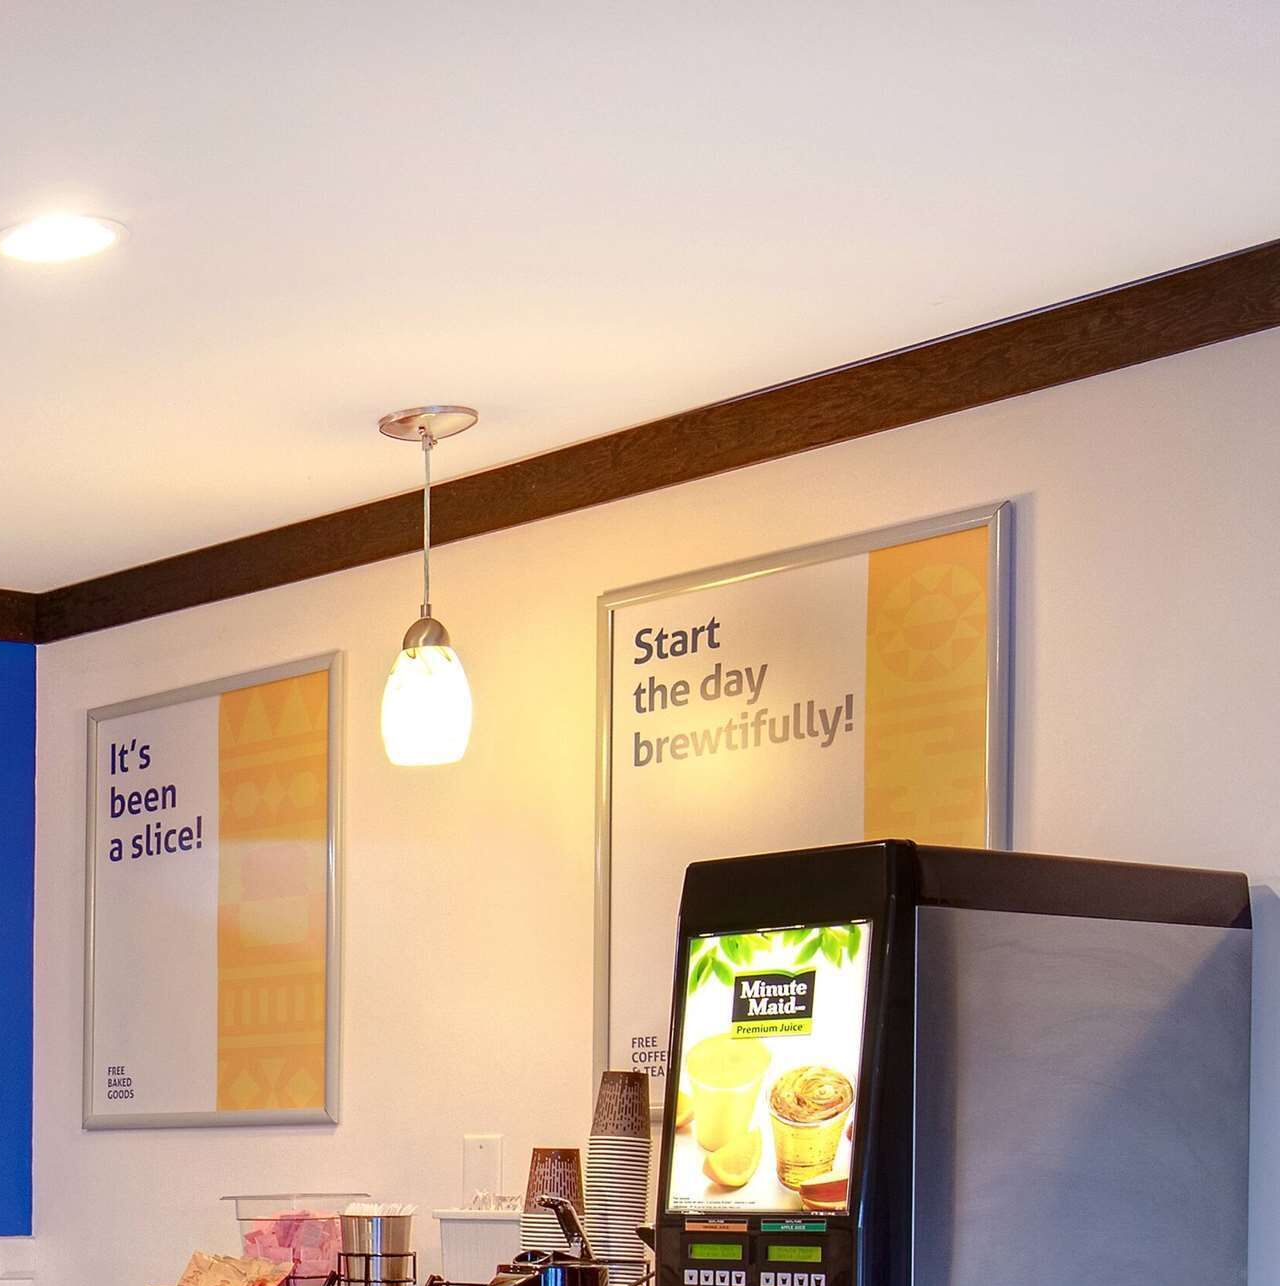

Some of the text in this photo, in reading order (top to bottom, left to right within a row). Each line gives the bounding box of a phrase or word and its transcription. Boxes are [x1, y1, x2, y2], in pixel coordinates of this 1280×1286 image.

[634, 616, 720, 665] Start
[633, 662, 768, 714] the day
[633, 693, 854, 767] brewtifully!
[110, 738, 151, 775] It's
[110, 784, 177, 818] been
[109, 815, 202, 862] a slice!
[740, 979, 808, 999] Minute
[747, 996, 797, 1016] Maid
[736, 1022, 803, 1034] Premium Juice
[631, 1036, 657, 1048] FREE
[631, 1050, 667, 1063] COFFE
[107, 1066, 125, 1076] FREE
[644, 1065, 665, 1077] TEA
[107, 1077, 132, 1087] BAKED
[107, 1089, 135, 1100] GOODS
